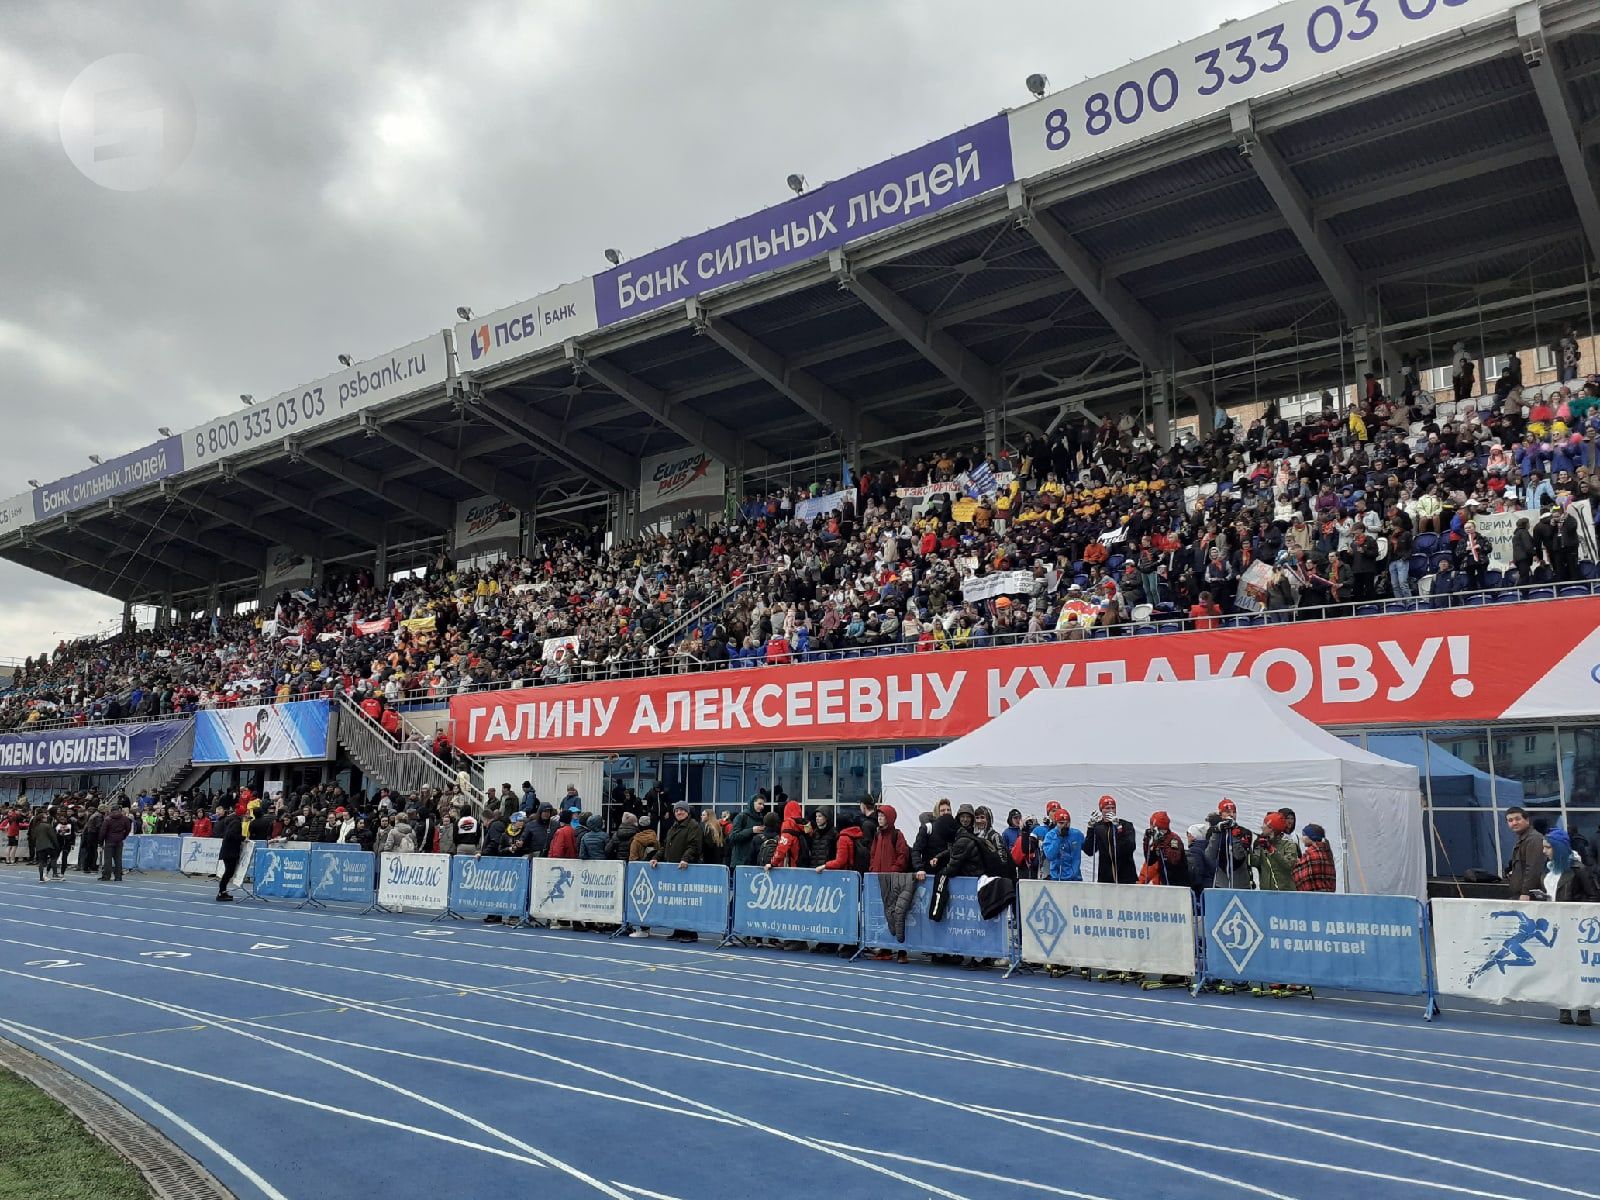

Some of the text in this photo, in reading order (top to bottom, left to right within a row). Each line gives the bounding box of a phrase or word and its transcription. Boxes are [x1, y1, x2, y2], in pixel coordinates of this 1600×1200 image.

[1045, 0, 1379, 151] 8 800 333 03
[617, 142, 981, 309] Банк сильных людей
[495, 303, 577, 348] ПСБ БАНК
[339, 353, 426, 408] psbank.ru
[195, 387, 325, 458] 8 800 333 03 03
[42, 448, 167, 513] Банк сильных людей
[468, 696, 620, 743] ГАЛИНУ
[629, 671, 967, 734] АЛЕКСЕЕВНУ
[49, 735, 130, 765] ЮБИЛЕЕМ
[1072, 904, 1187, 924] Сила в движении
[1073, 924, 1151, 940] и единстве!
[1269, 916, 1413, 937] Сила в движении
[1270, 937, 1366, 955] и единстве!
